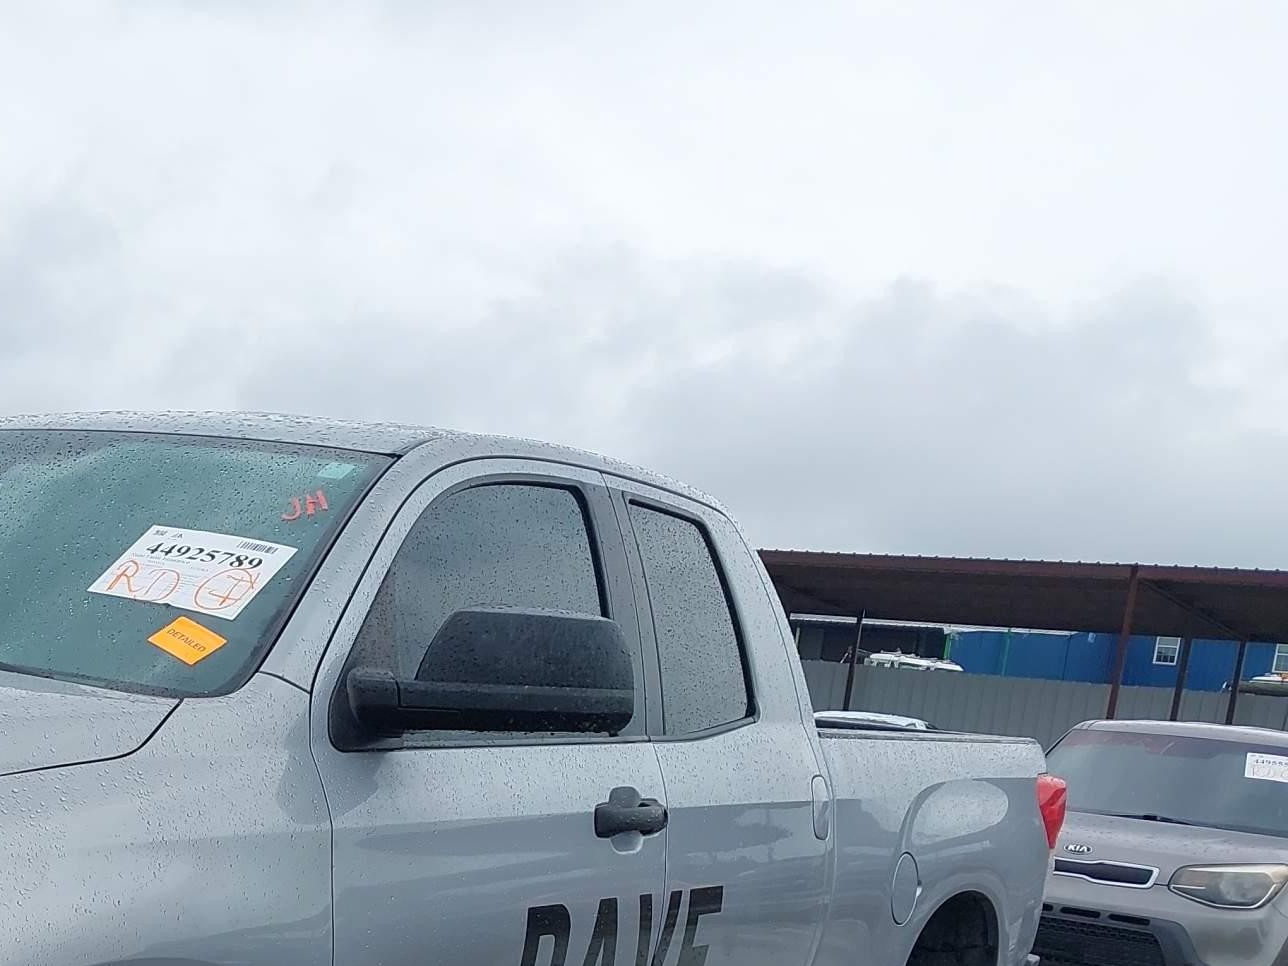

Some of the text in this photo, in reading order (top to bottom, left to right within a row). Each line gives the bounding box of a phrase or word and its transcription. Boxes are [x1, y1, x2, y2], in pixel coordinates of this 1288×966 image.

[146, 541, 264, 570] 44925789
[166, 628, 207, 652] DETAILED
[1066, 843, 1089, 854] KIA
